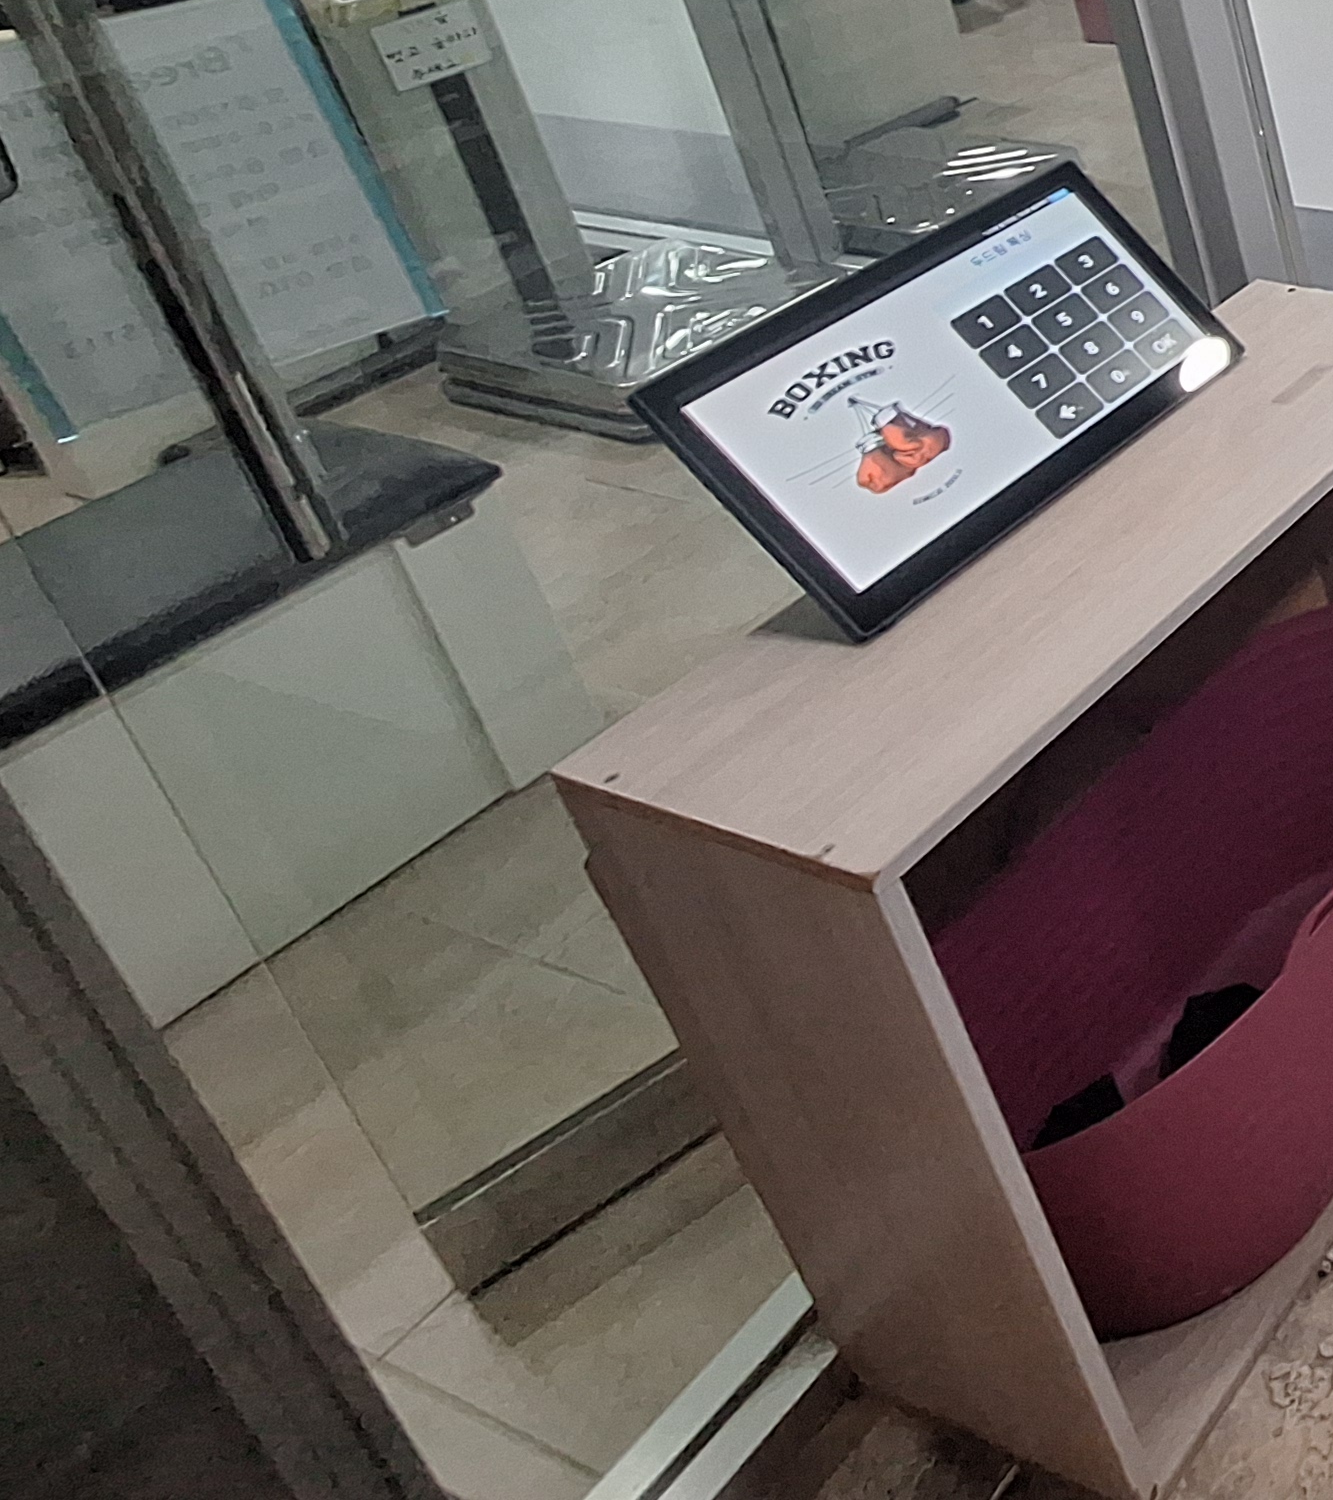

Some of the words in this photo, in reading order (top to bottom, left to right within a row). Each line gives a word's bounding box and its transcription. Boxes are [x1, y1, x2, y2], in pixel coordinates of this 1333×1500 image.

[1078, 254, 1094, 269] 3
[1029, 283, 1047, 299] 2
[1106, 282, 1119, 295] 6
[977, 315, 994, 329] 1
[1056, 312, 1073, 327] 5
[1131, 311, 1145, 323] 9
[1007, 344, 1023, 359] 4
[1083, 342, 1099, 355] 8
[1152, 334, 1177, 354] OK
[768, 340, 896, 419] BOXING
[1031, 373, 1048, 389] 7
[1110, 370, 1125, 383] 0
